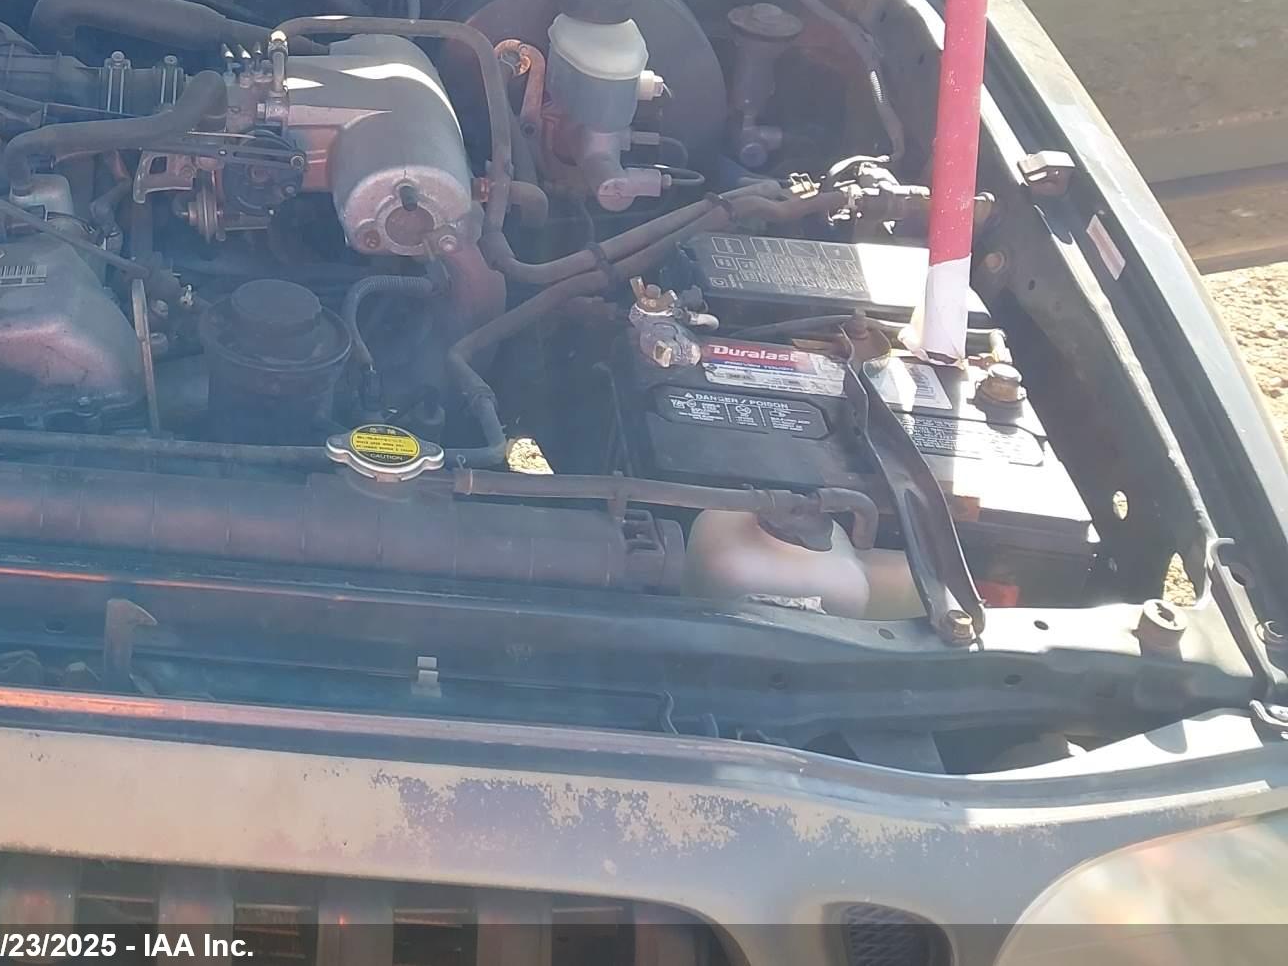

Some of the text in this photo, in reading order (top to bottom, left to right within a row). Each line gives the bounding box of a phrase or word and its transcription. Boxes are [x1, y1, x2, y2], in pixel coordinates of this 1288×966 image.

[708, 344, 800, 362] Duralast
[695, 393, 739, 405] DANGER
[749, 400, 790, 410] POISON
